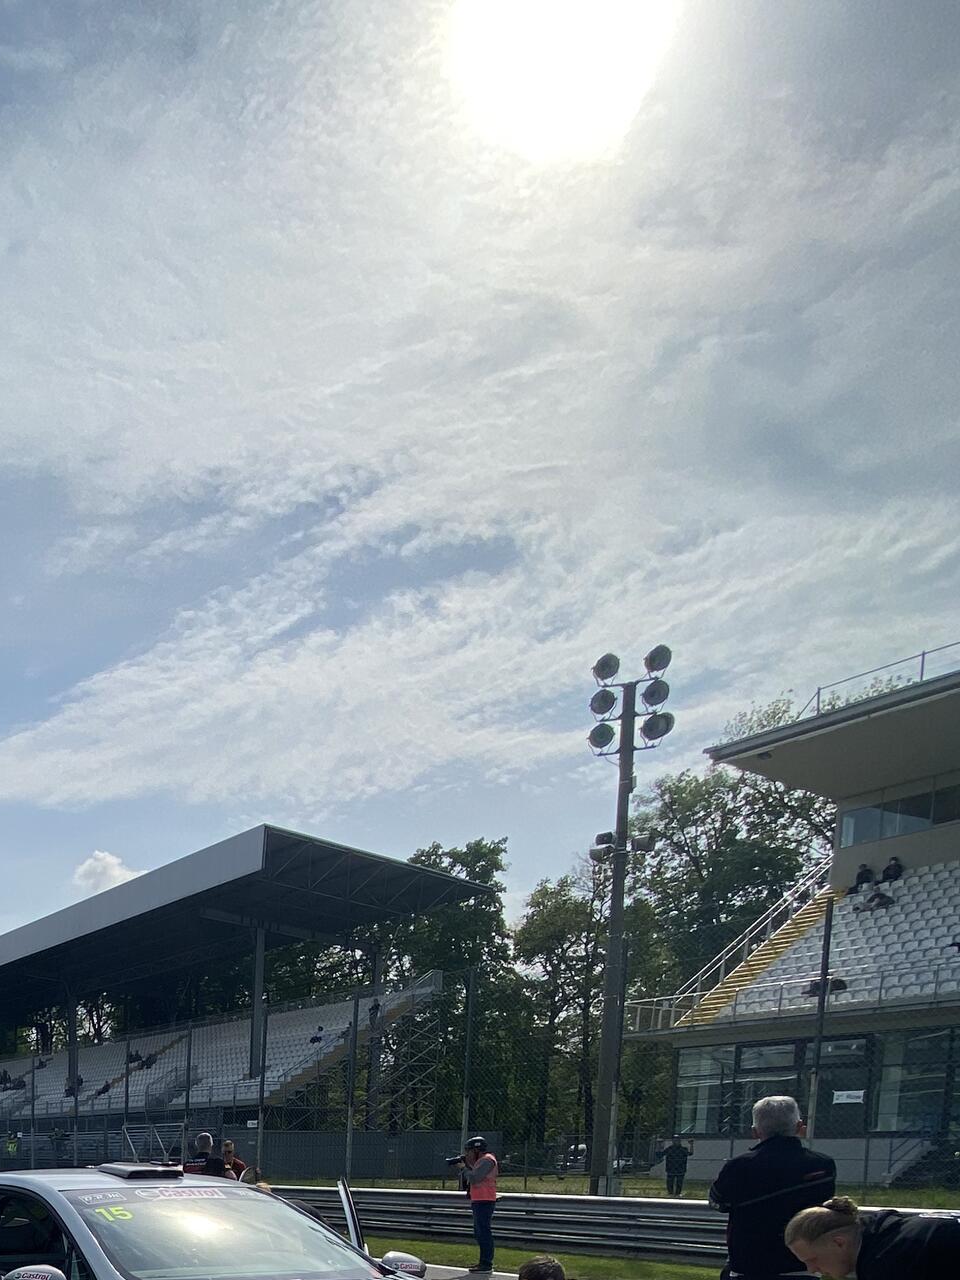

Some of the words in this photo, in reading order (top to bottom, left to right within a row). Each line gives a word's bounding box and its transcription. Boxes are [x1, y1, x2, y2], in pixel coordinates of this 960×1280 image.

[159, 1188, 219, 1198] Castrol
[94, 1206, 134, 1222] 15
[21, 1272, 50, 1280] Castrol
